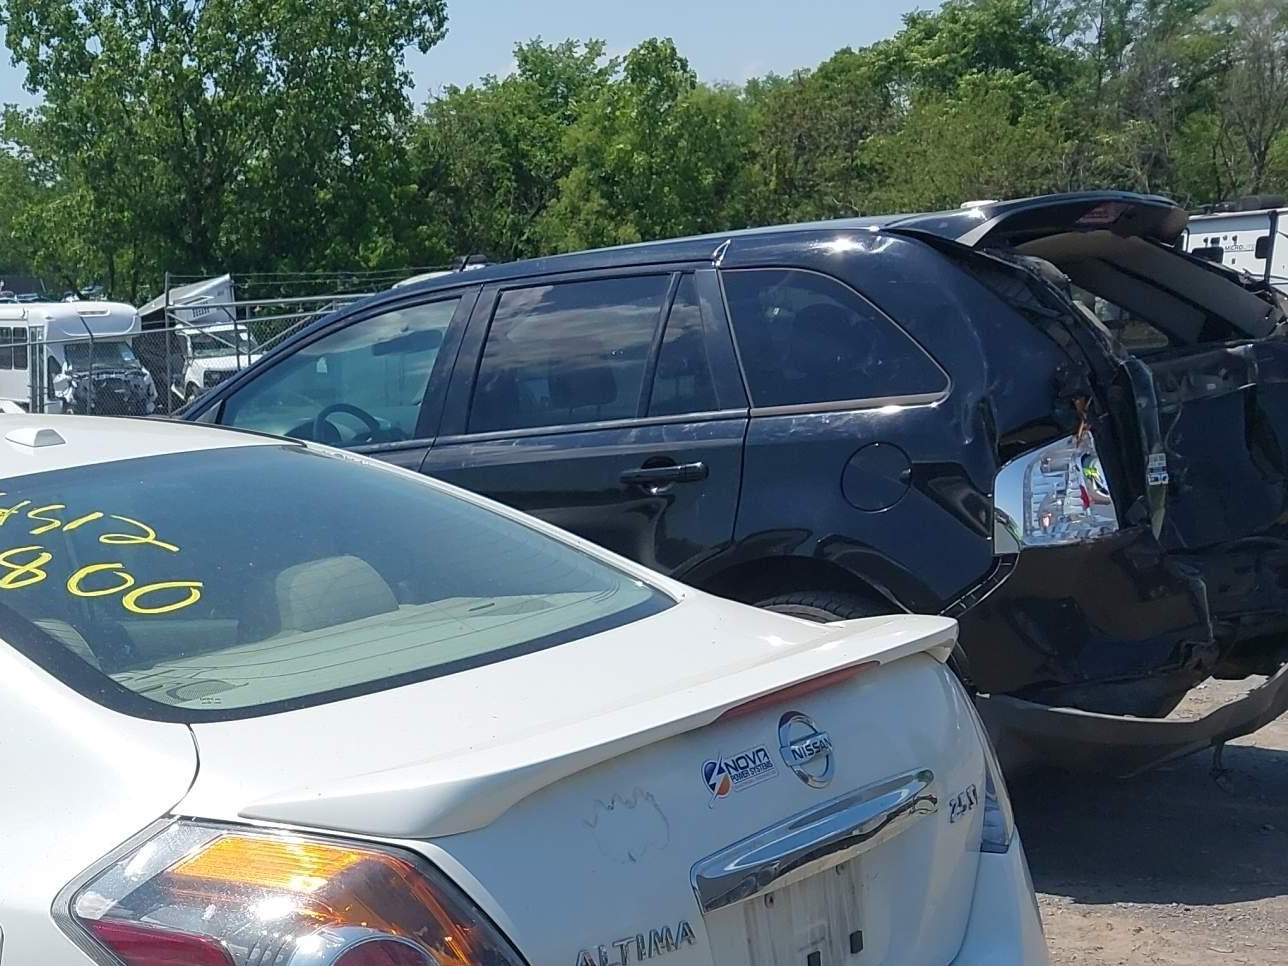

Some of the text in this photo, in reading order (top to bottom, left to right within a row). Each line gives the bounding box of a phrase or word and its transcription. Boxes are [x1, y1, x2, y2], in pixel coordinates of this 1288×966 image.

[723, 747, 770, 775] NOVA
[791, 736, 832, 761] NISSAN
[731, 767, 750, 782] POWER
[750, 760, 774, 776] SYSTEMS
